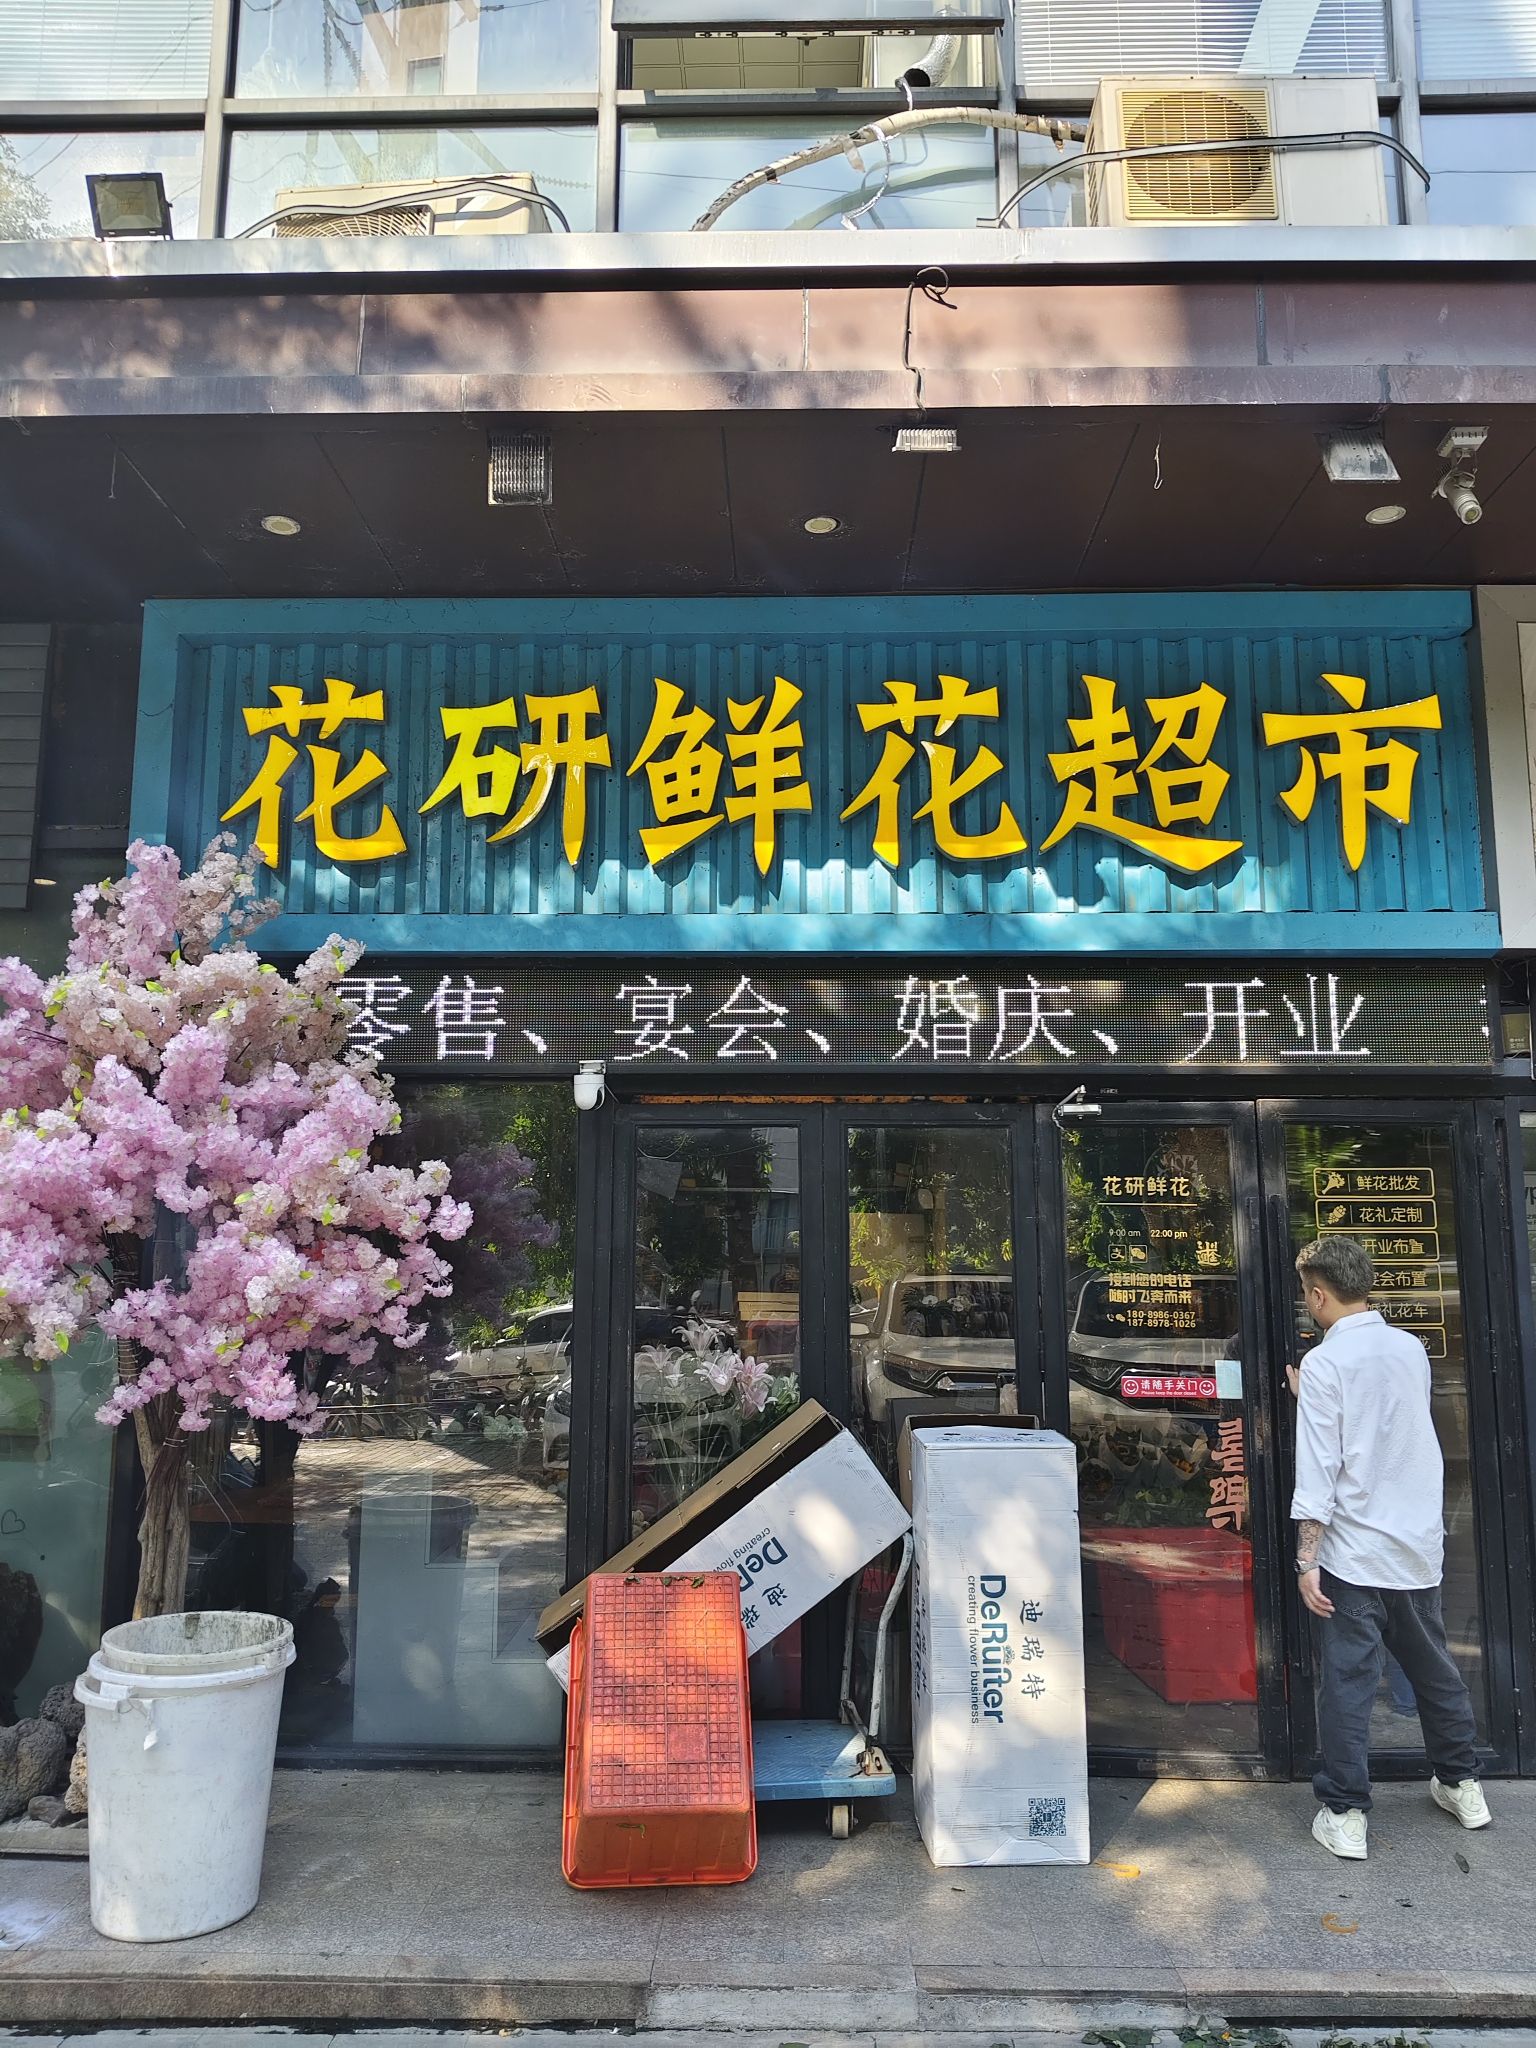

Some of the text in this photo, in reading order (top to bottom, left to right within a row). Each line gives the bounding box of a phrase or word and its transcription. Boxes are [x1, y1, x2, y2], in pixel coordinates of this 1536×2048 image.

[219, 673, 1443, 878] 花研鲜花超市
[1102, 1175, 1190, 1197] 花研鲜花
[1356, 1175, 1421, 1192] 鲜花批发
[1359, 1206, 1423, 1224] 花礼定制
[1150, 1229, 1173, 1238] 22:00
[1174, 1231, 1188, 1240] pm
[1361, 1238, 1426, 1255] 开业布置
[1108, 1272, 1192, 1288] 接到您的电话
[1108, 1288, 1192, 1304] 随时飞奔而来
[1126, 1309, 1196, 1319] 180-8986-0367
[1126, 1318, 1196, 1328] 187-8978-1026
[1140, 1379, 1198, 1391] 请随手关门
[732, 1527, 771, 1559] creating
[967, 1575, 980, 1724] creating flower business
[980, 1574, 1013, 1724] DeRuiter
[1019, 1599, 1046, 1700] 迪瑞特
